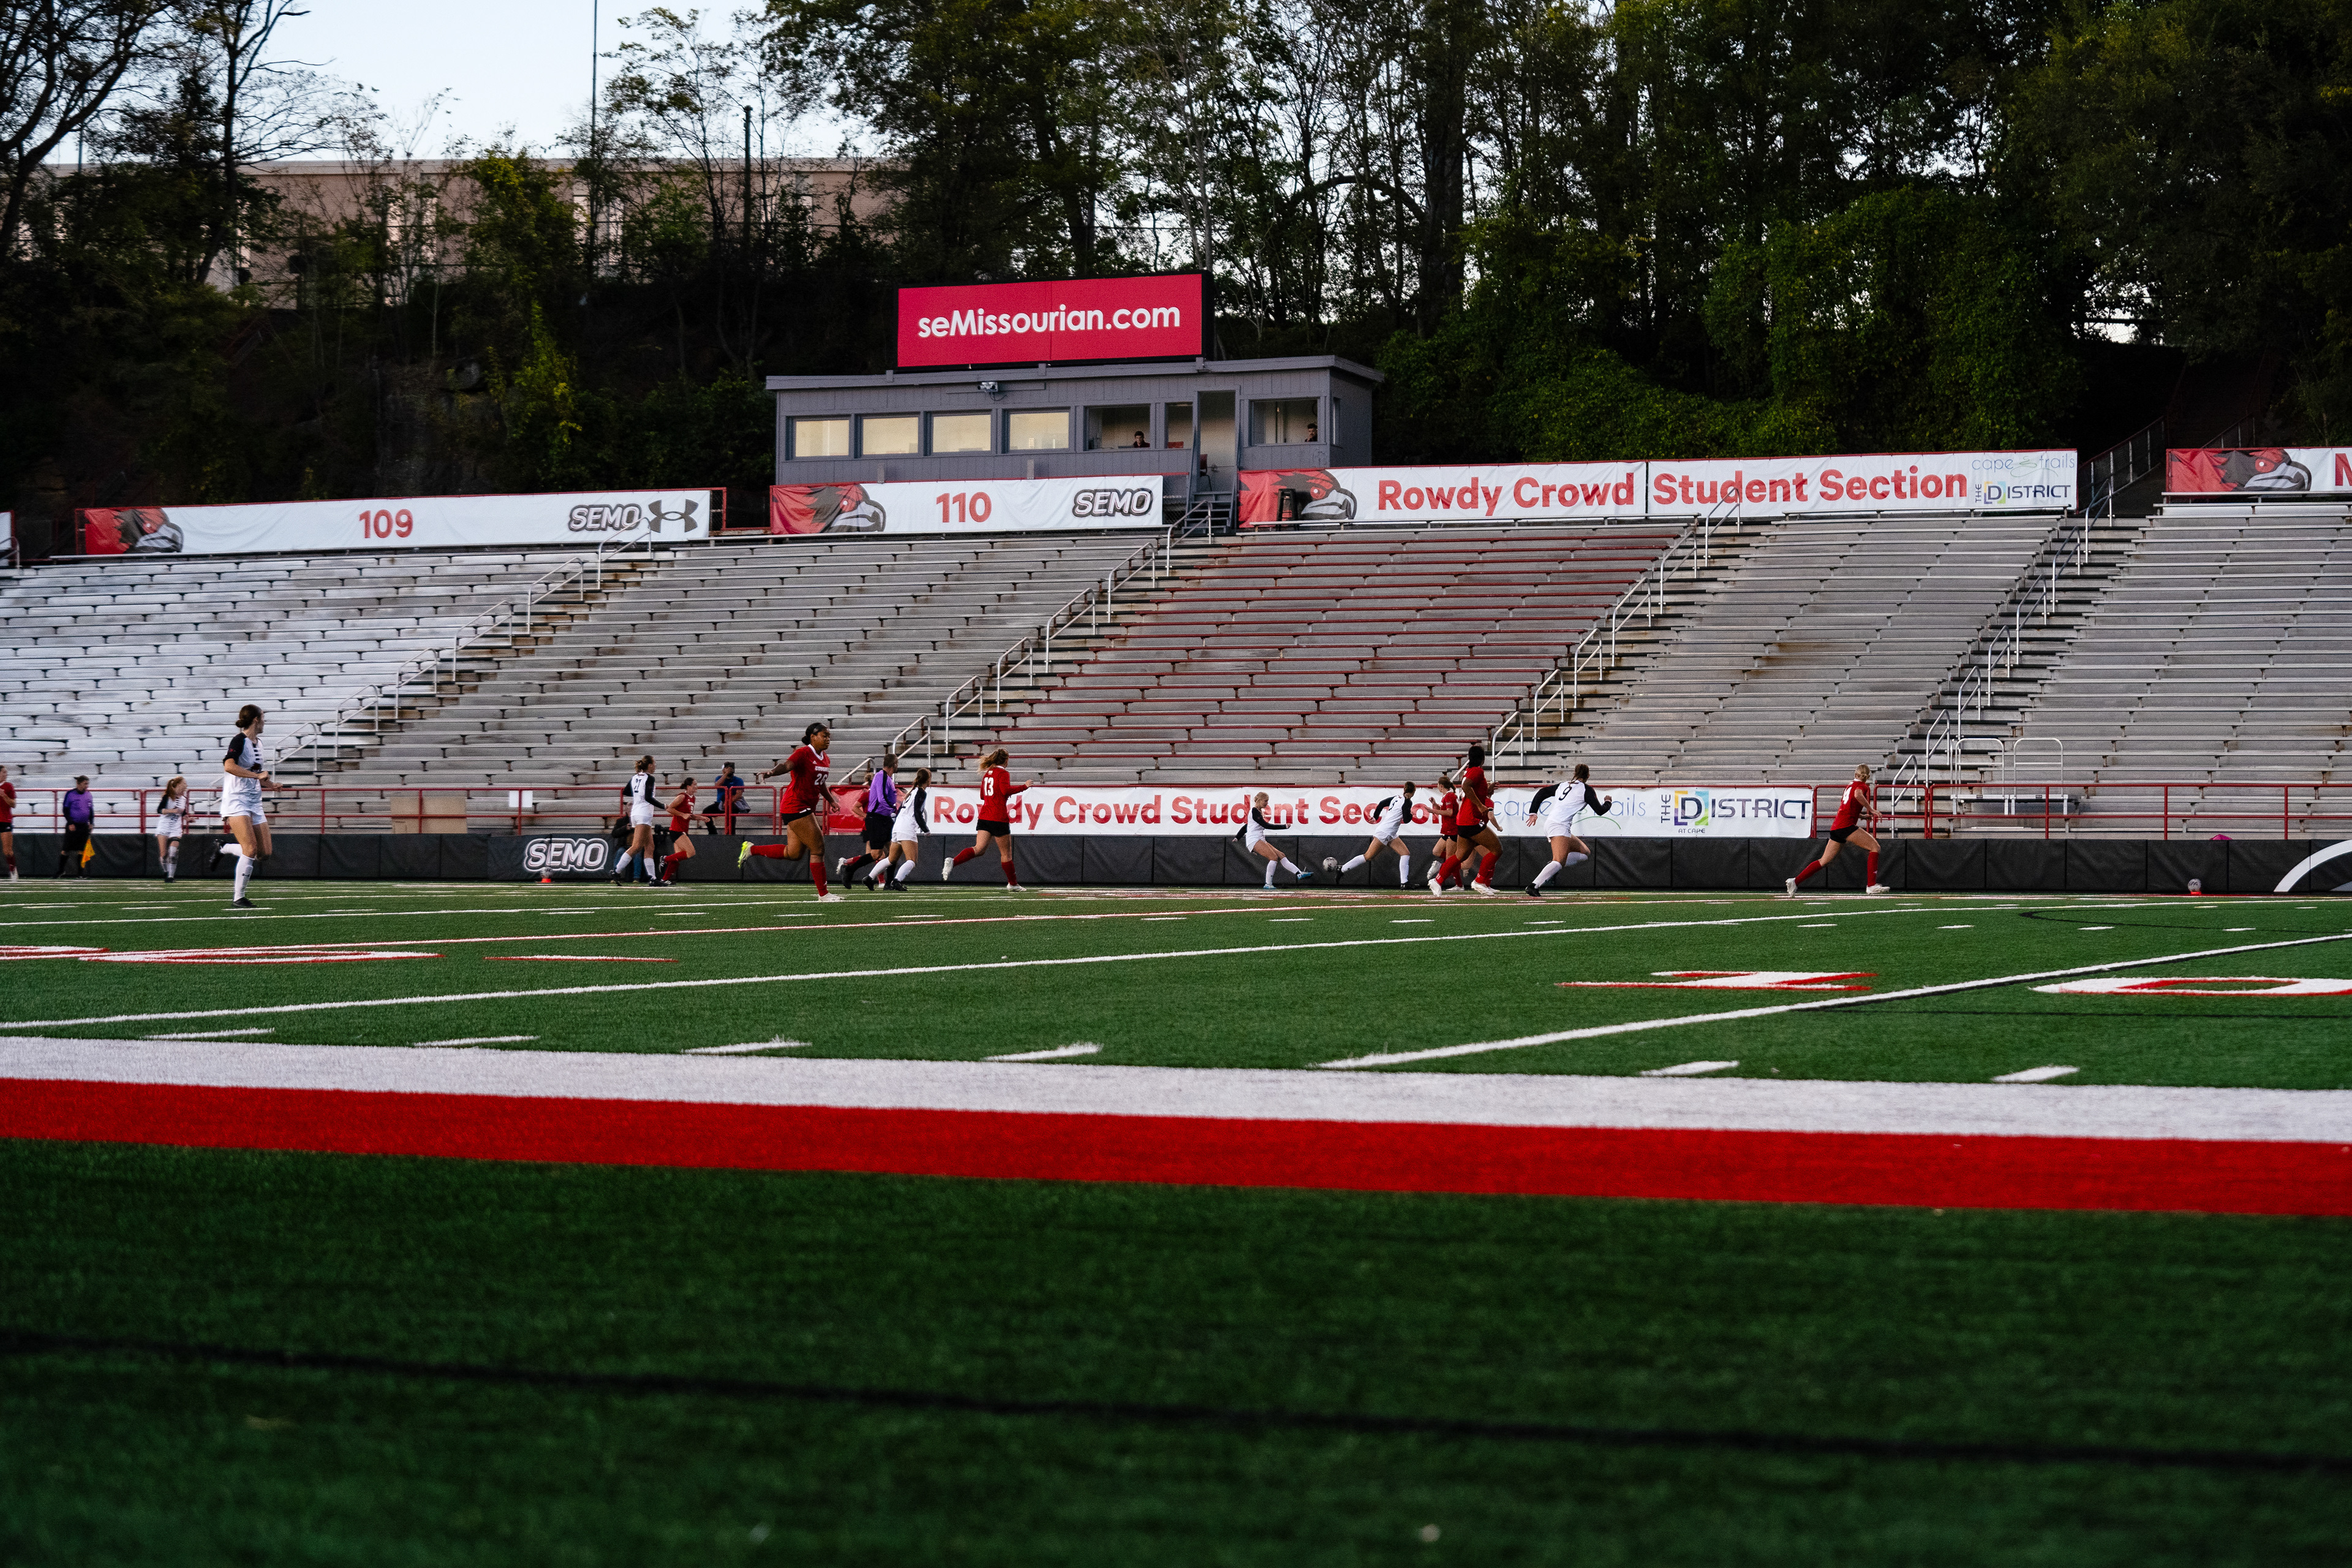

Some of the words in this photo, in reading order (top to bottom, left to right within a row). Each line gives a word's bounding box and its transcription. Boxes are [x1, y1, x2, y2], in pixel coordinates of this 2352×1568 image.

[918, 304, 1180, 337] seMissourian.com
[1972, 459, 2013, 472] cape
[2040, 453, 2075, 468] trails
[1072, 488, 1153, 518] SEMO
[1378, 477, 1502, 516] Rowdy
[1513, 473, 1634, 508] Crowd
[1653, 470, 1808, 505] Student
[1819, 466, 1967, 502] Section
[1988, 485, 2071, 500] DISTRICT
[568, 503, 642, 532] SEMO
[936, 492, 992, 523] 110
[359, 509, 413, 538] 109
[815, 773, 828, 785] 26
[984, 777, 994, 796] 13
[1559, 786, 1572, 801] 9
[934, 795, 1044, 830] Rody
[1054, 795, 1161, 824] Crowd
[1593, 794, 1646, 816] ails
[1661, 794, 1671, 823] THE
[1681, 797, 1811, 819] DISTRICT
[524, 838, 609, 872] SEMO
